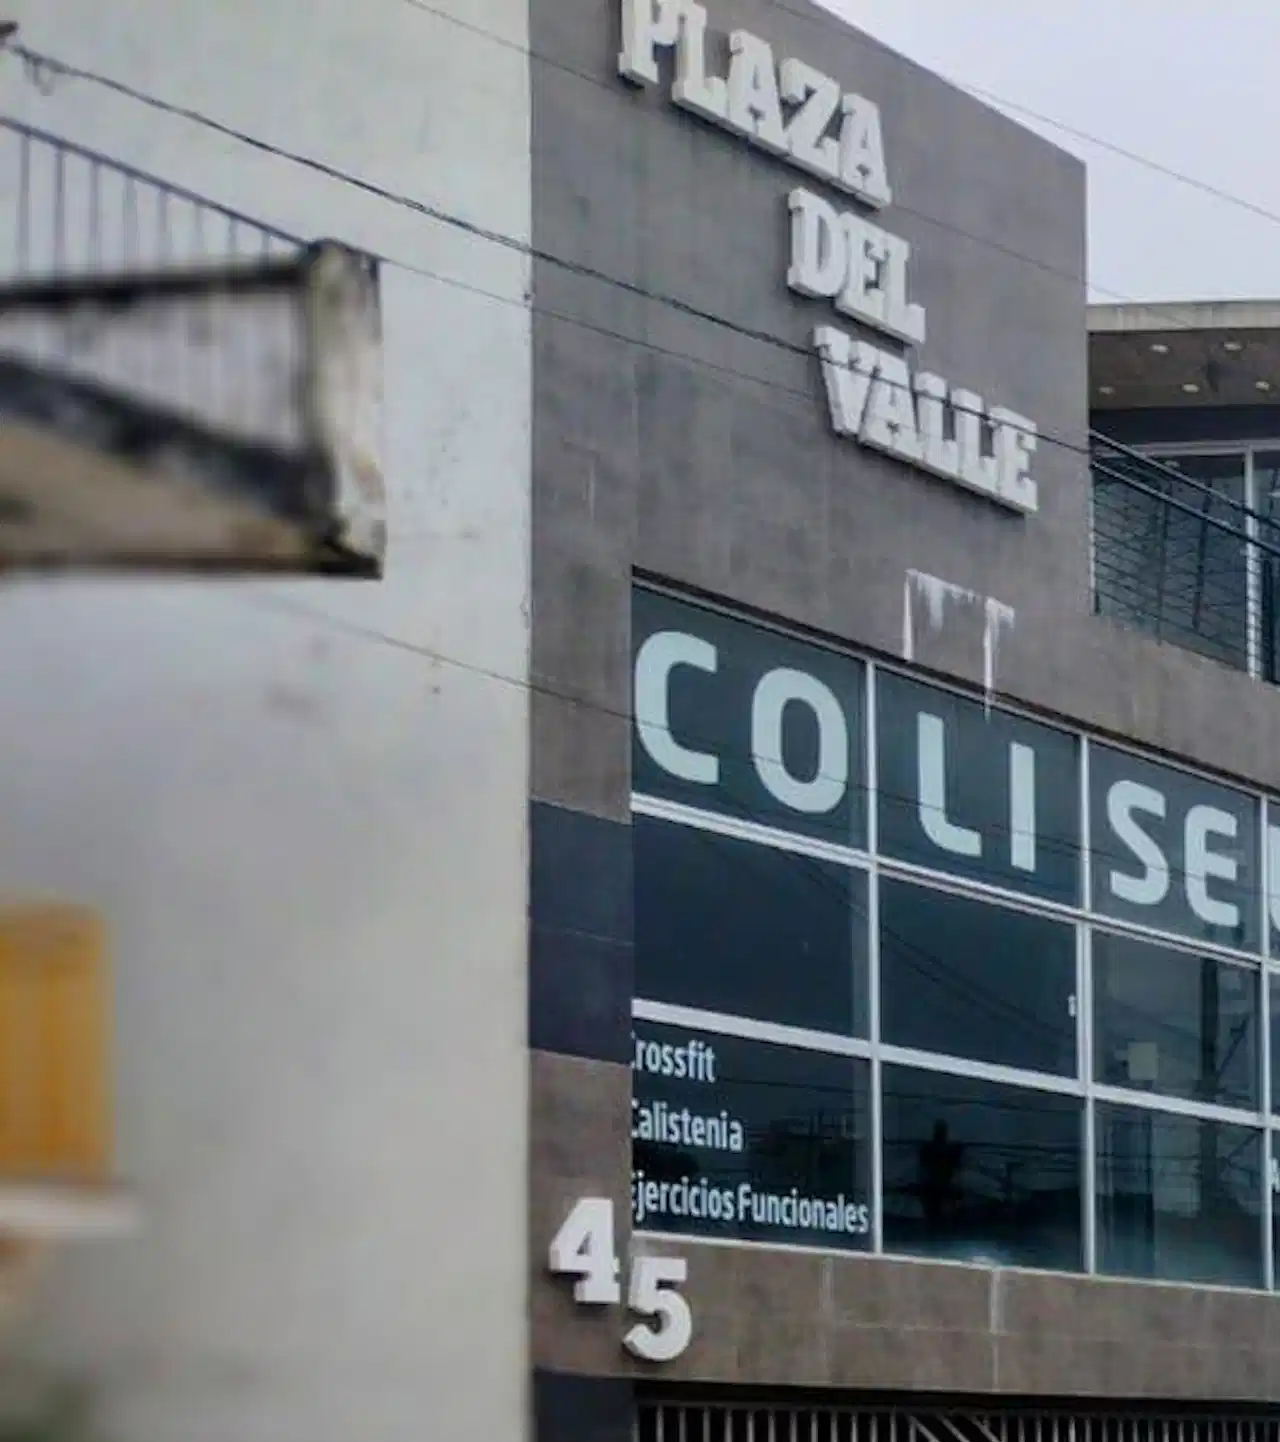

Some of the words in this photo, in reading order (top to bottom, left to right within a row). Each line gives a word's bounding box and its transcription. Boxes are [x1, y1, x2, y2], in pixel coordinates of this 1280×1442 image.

[617, 0, 892, 209] PLAZA
[787, 187, 925, 344] DEL
[814, 326, 1039, 514] VALLE
[631, 1031, 716, 1083] rossfit
[737, 1184, 869, 1235] Funcionales
